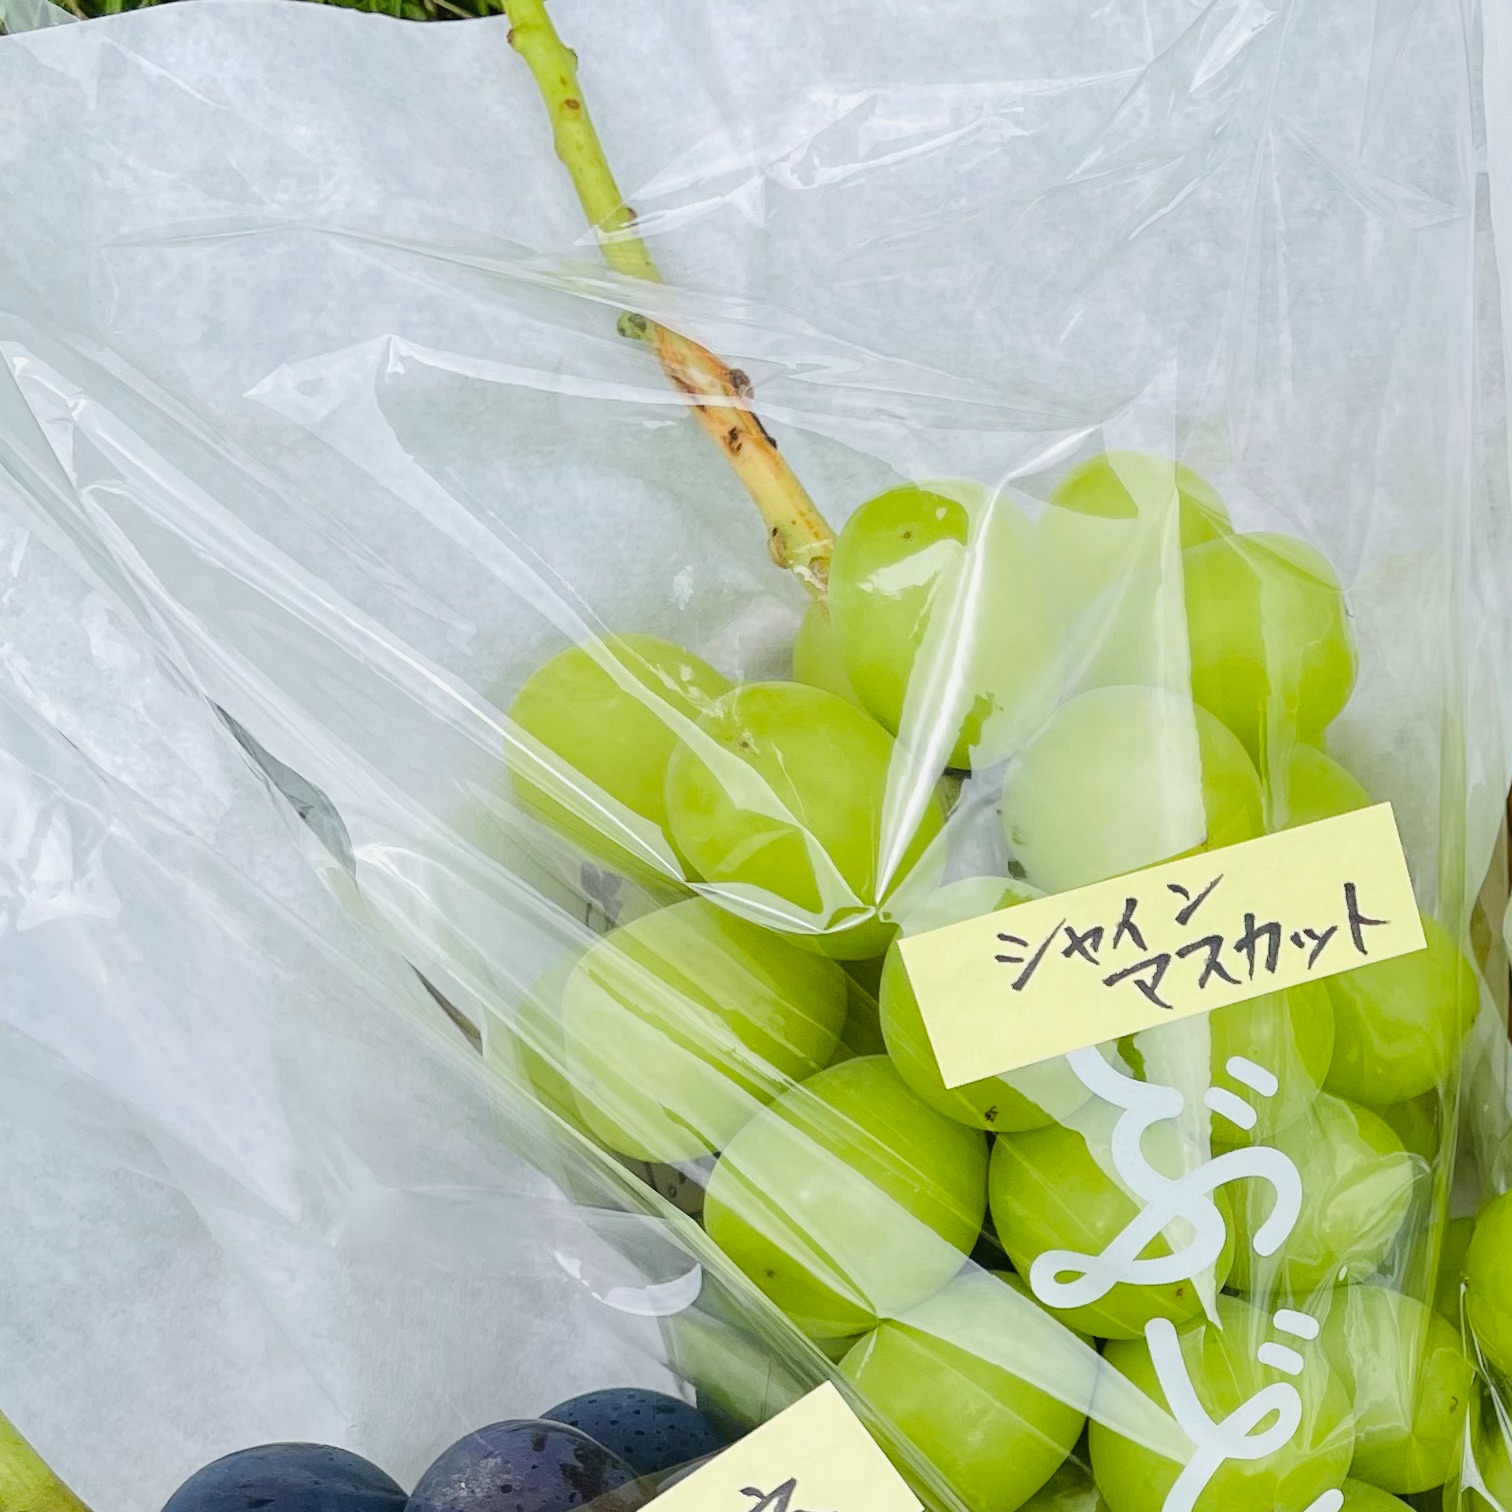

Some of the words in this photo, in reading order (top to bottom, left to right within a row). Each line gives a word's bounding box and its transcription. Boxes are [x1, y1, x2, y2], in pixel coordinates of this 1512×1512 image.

[995, 874, 1224, 991] シャイン
[1103, 882, 1391, 1010] マスカット
